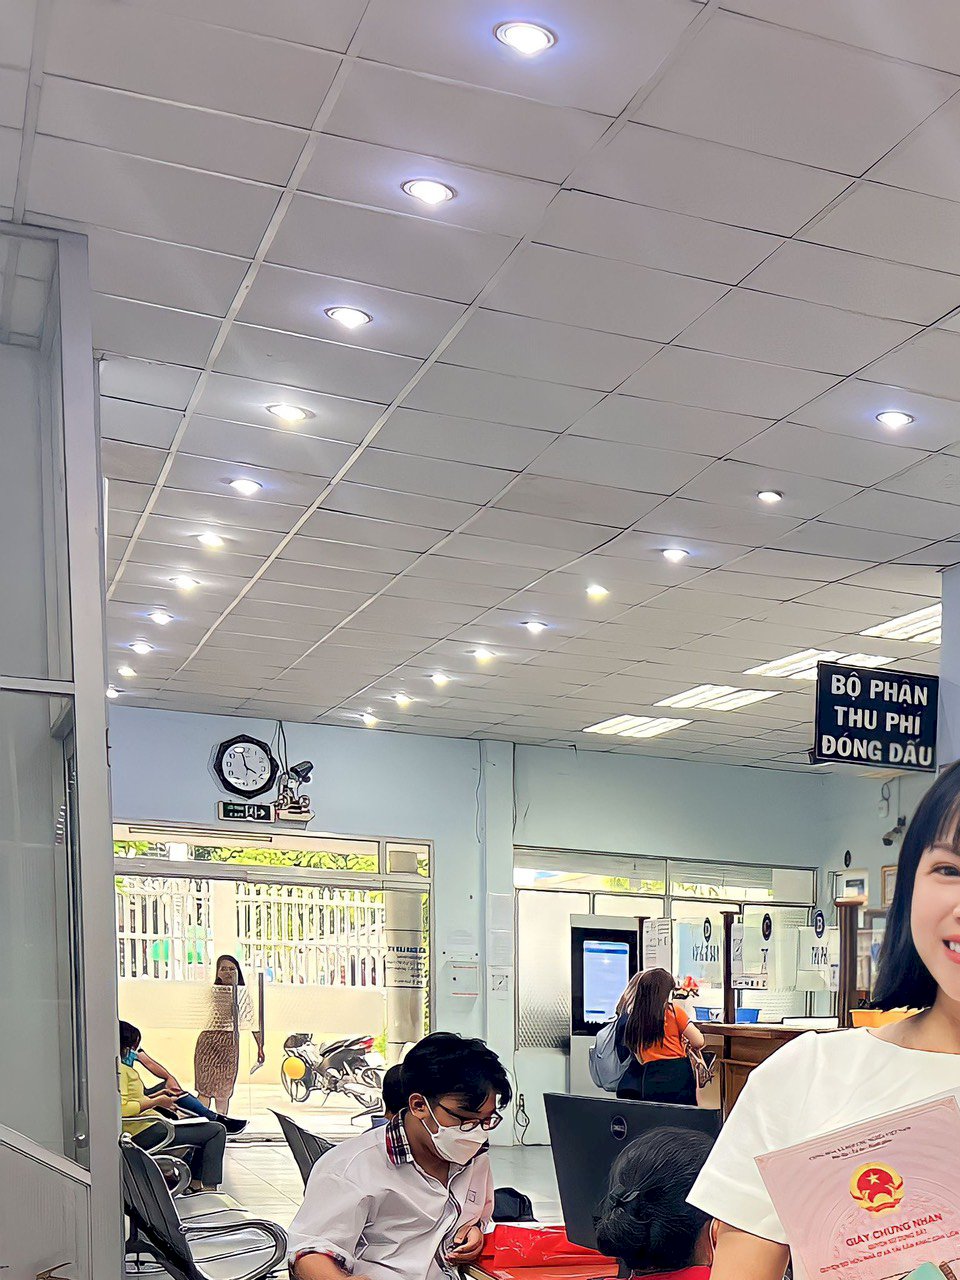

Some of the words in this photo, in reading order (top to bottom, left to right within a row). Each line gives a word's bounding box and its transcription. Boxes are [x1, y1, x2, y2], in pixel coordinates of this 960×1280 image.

[831, 671, 862, 700] BỘ
[870, 679, 928, 707] PHẬN
[834, 705, 877, 730] THU
[885, 711, 922, 735] PHÍ
[822, 732, 882, 761] ĐÓNG
[889, 738, 932, 766] DẤU
